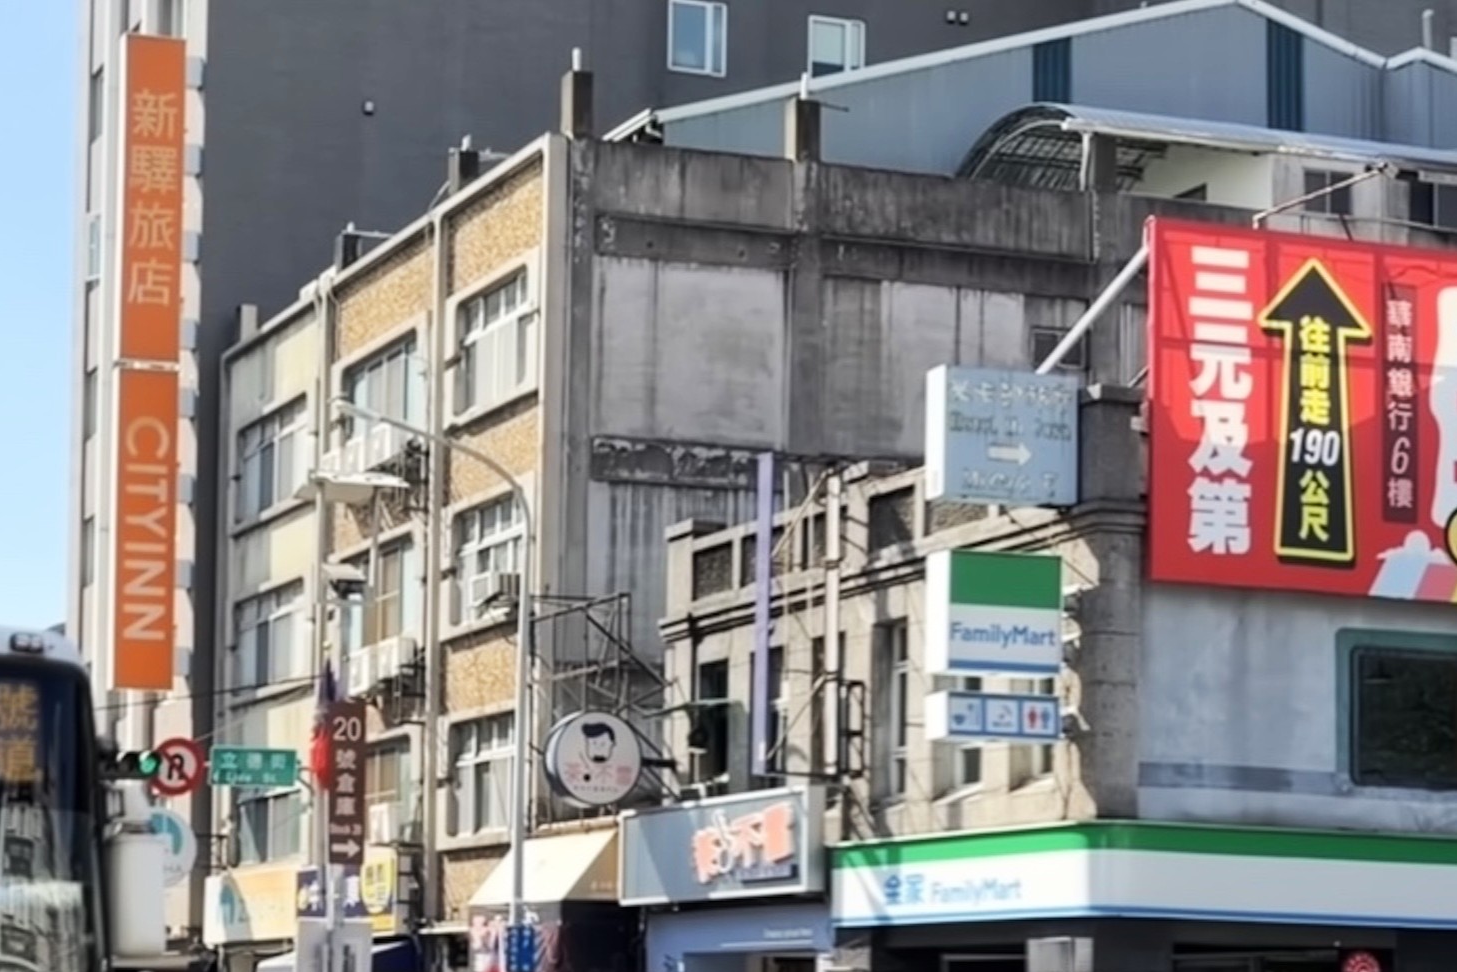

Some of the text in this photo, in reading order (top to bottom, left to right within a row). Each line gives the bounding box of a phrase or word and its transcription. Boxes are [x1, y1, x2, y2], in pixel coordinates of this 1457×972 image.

[128, 89, 178, 306] 新驛旅店
[1188, 246, 1254, 555] 三元及第
[1290, 314, 1341, 542] 往前走190公尺
[122, 417, 170, 642] CITYINN
[950, 621, 1057, 650] FamilyMart
[885, 874, 925, 905] 全家
[931, 879, 1022, 906] FamilyMart
